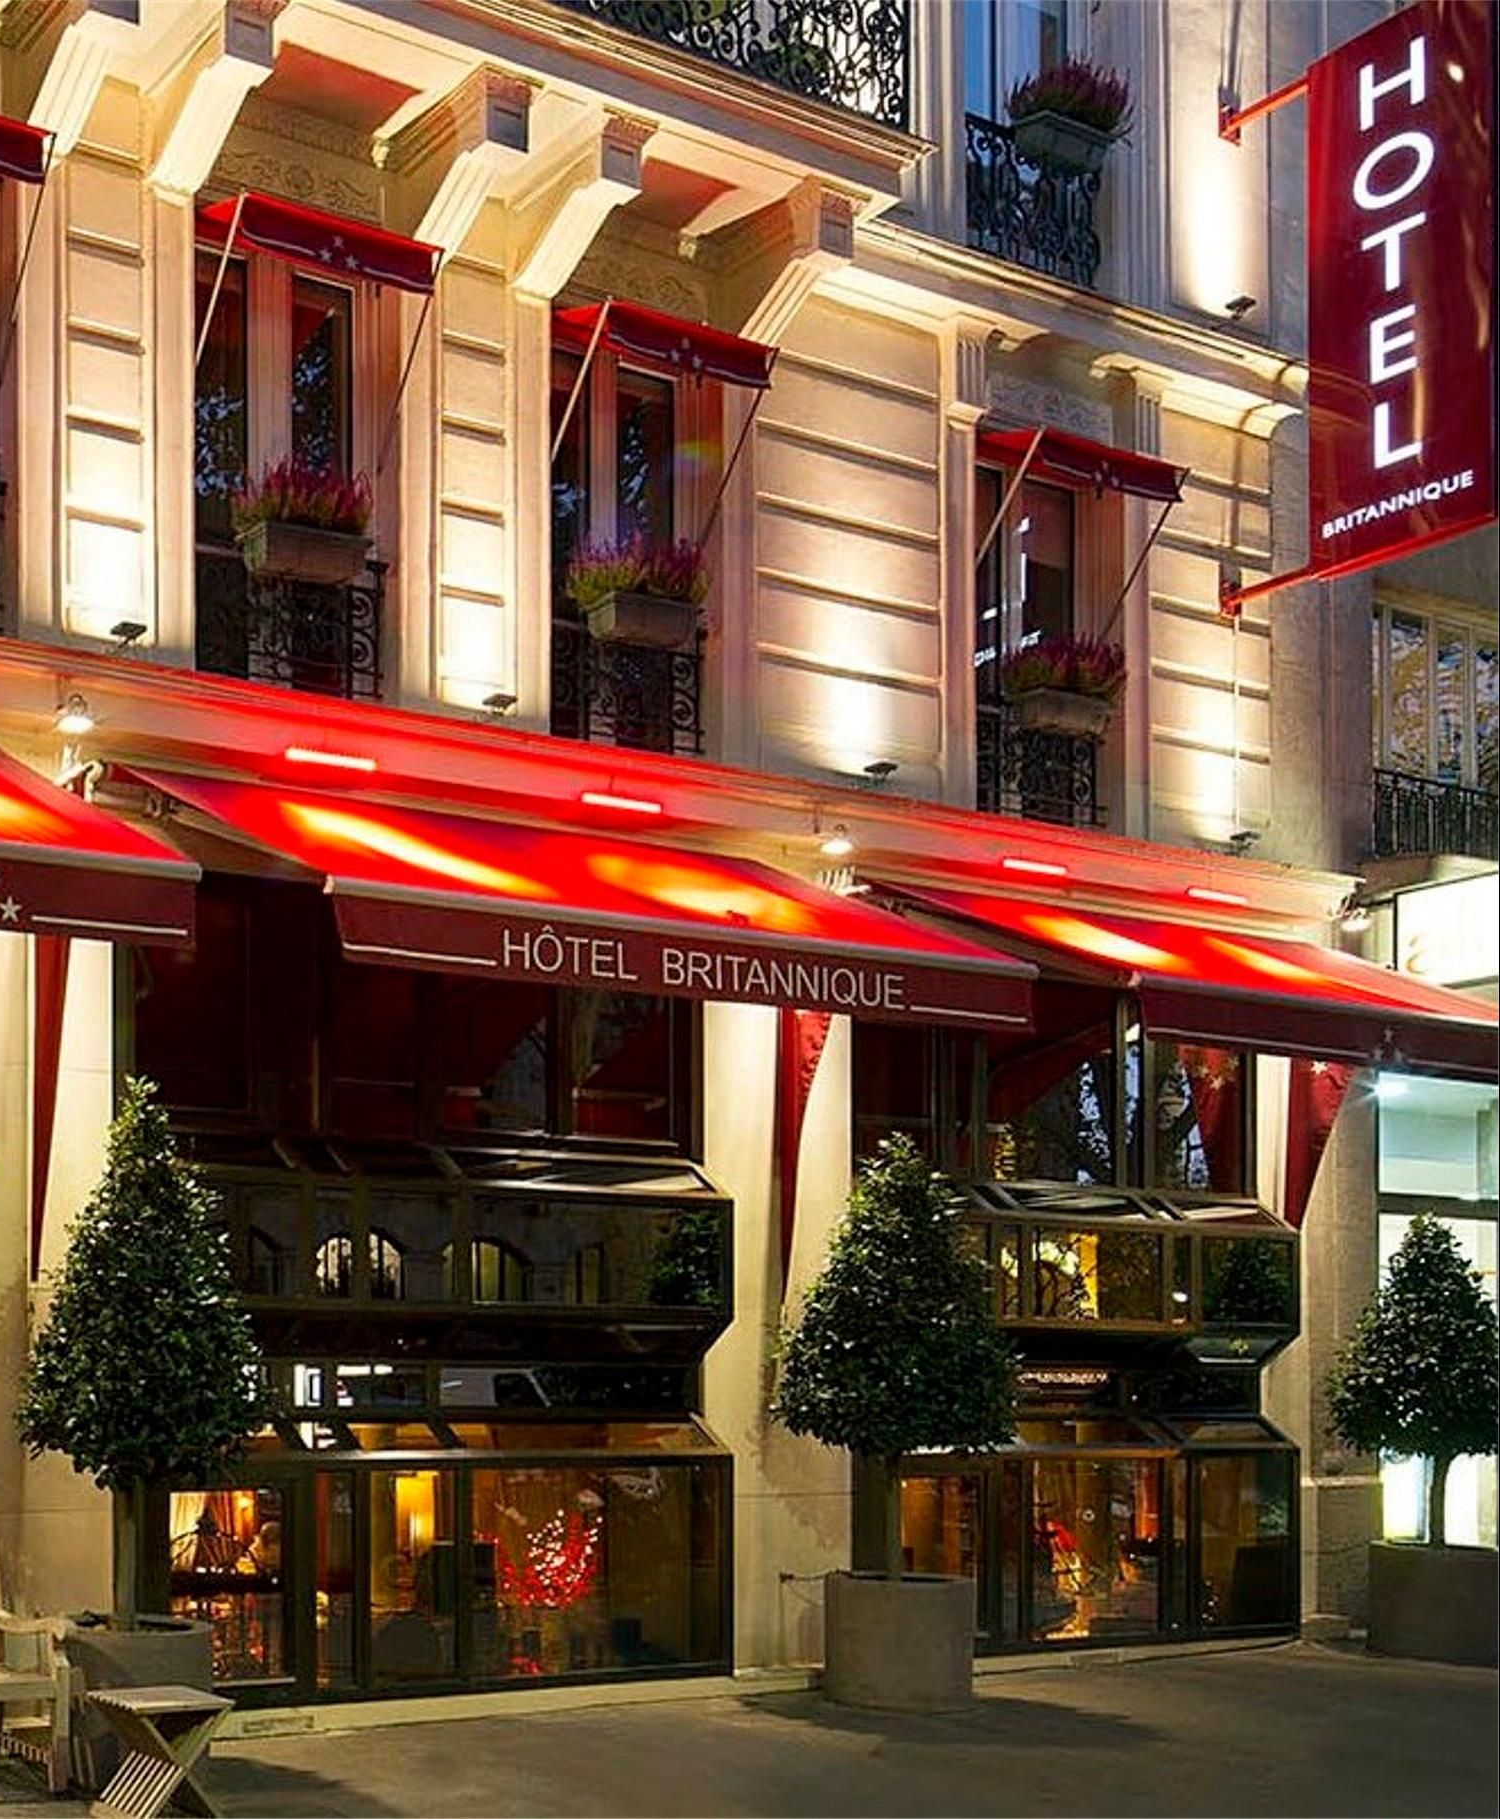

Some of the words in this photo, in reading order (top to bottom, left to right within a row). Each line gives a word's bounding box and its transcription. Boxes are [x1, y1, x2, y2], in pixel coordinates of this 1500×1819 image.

[1353, 35, 1434, 470] HOTEL
[1321, 469, 1474, 539] BRITANNIQUE
[502, 925, 638, 981] HÔTEL
[662, 947, 906, 1011] BRITANNIQUE
